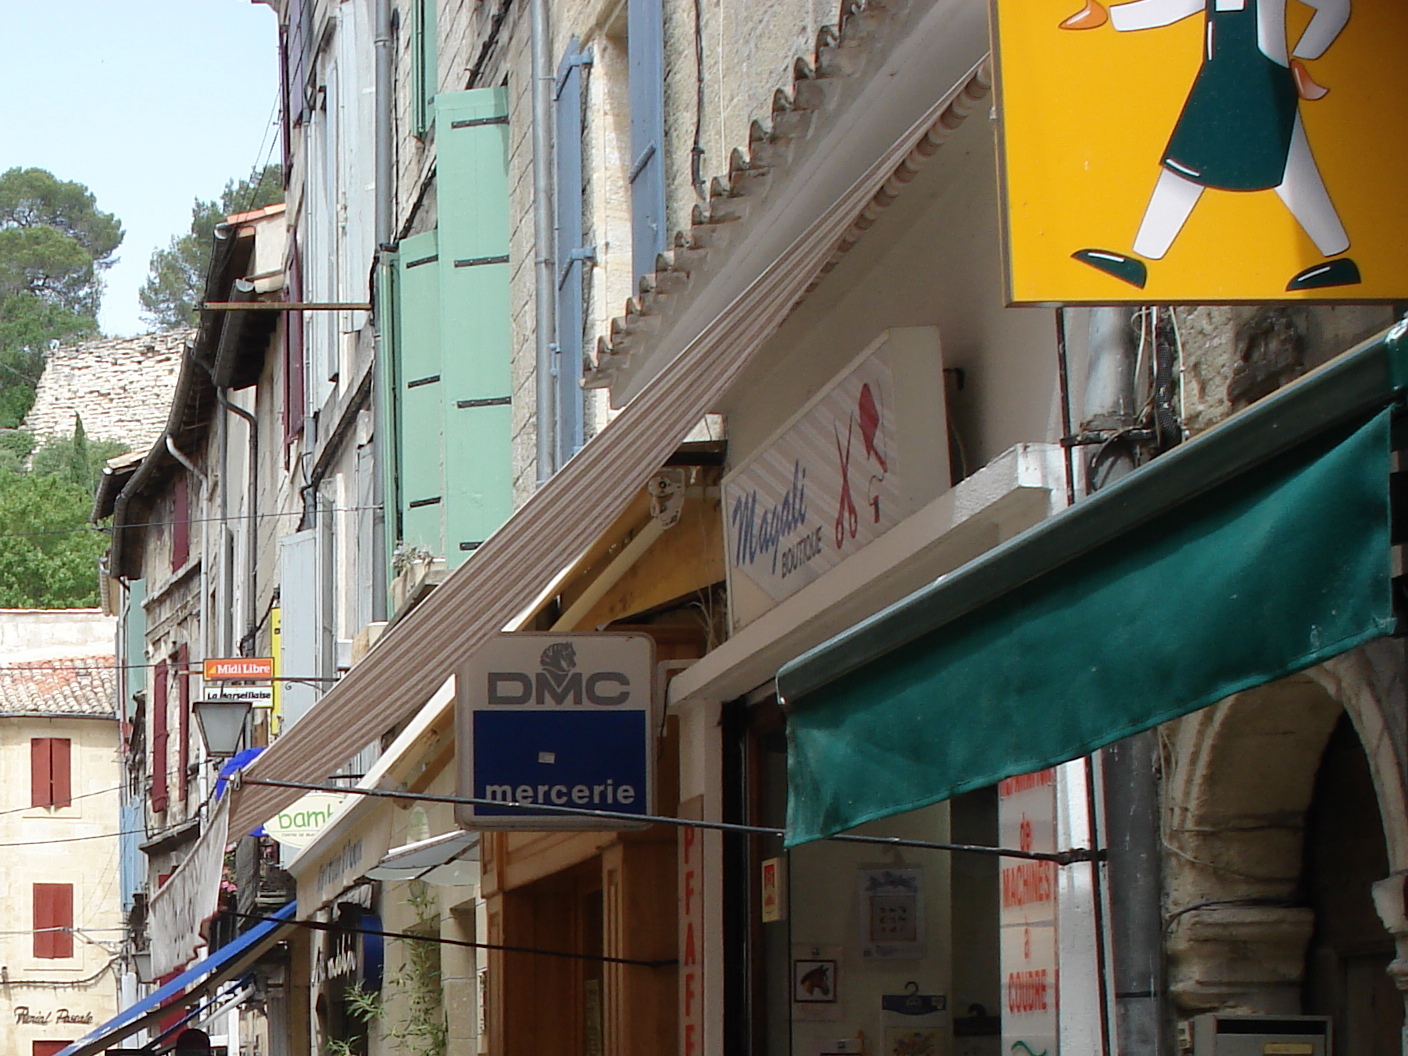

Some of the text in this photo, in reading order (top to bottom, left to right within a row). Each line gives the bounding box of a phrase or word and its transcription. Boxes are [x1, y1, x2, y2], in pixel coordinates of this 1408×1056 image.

[732, 458, 807, 575] Magali
[781, 525, 823, 578] BOUTIQUE
[217, 663, 271, 674] Midi Libre
[487, 671, 631, 706] DMC
[485, 779, 635, 804] mercerie
[1008, 968, 1047, 1013] COUDRE
